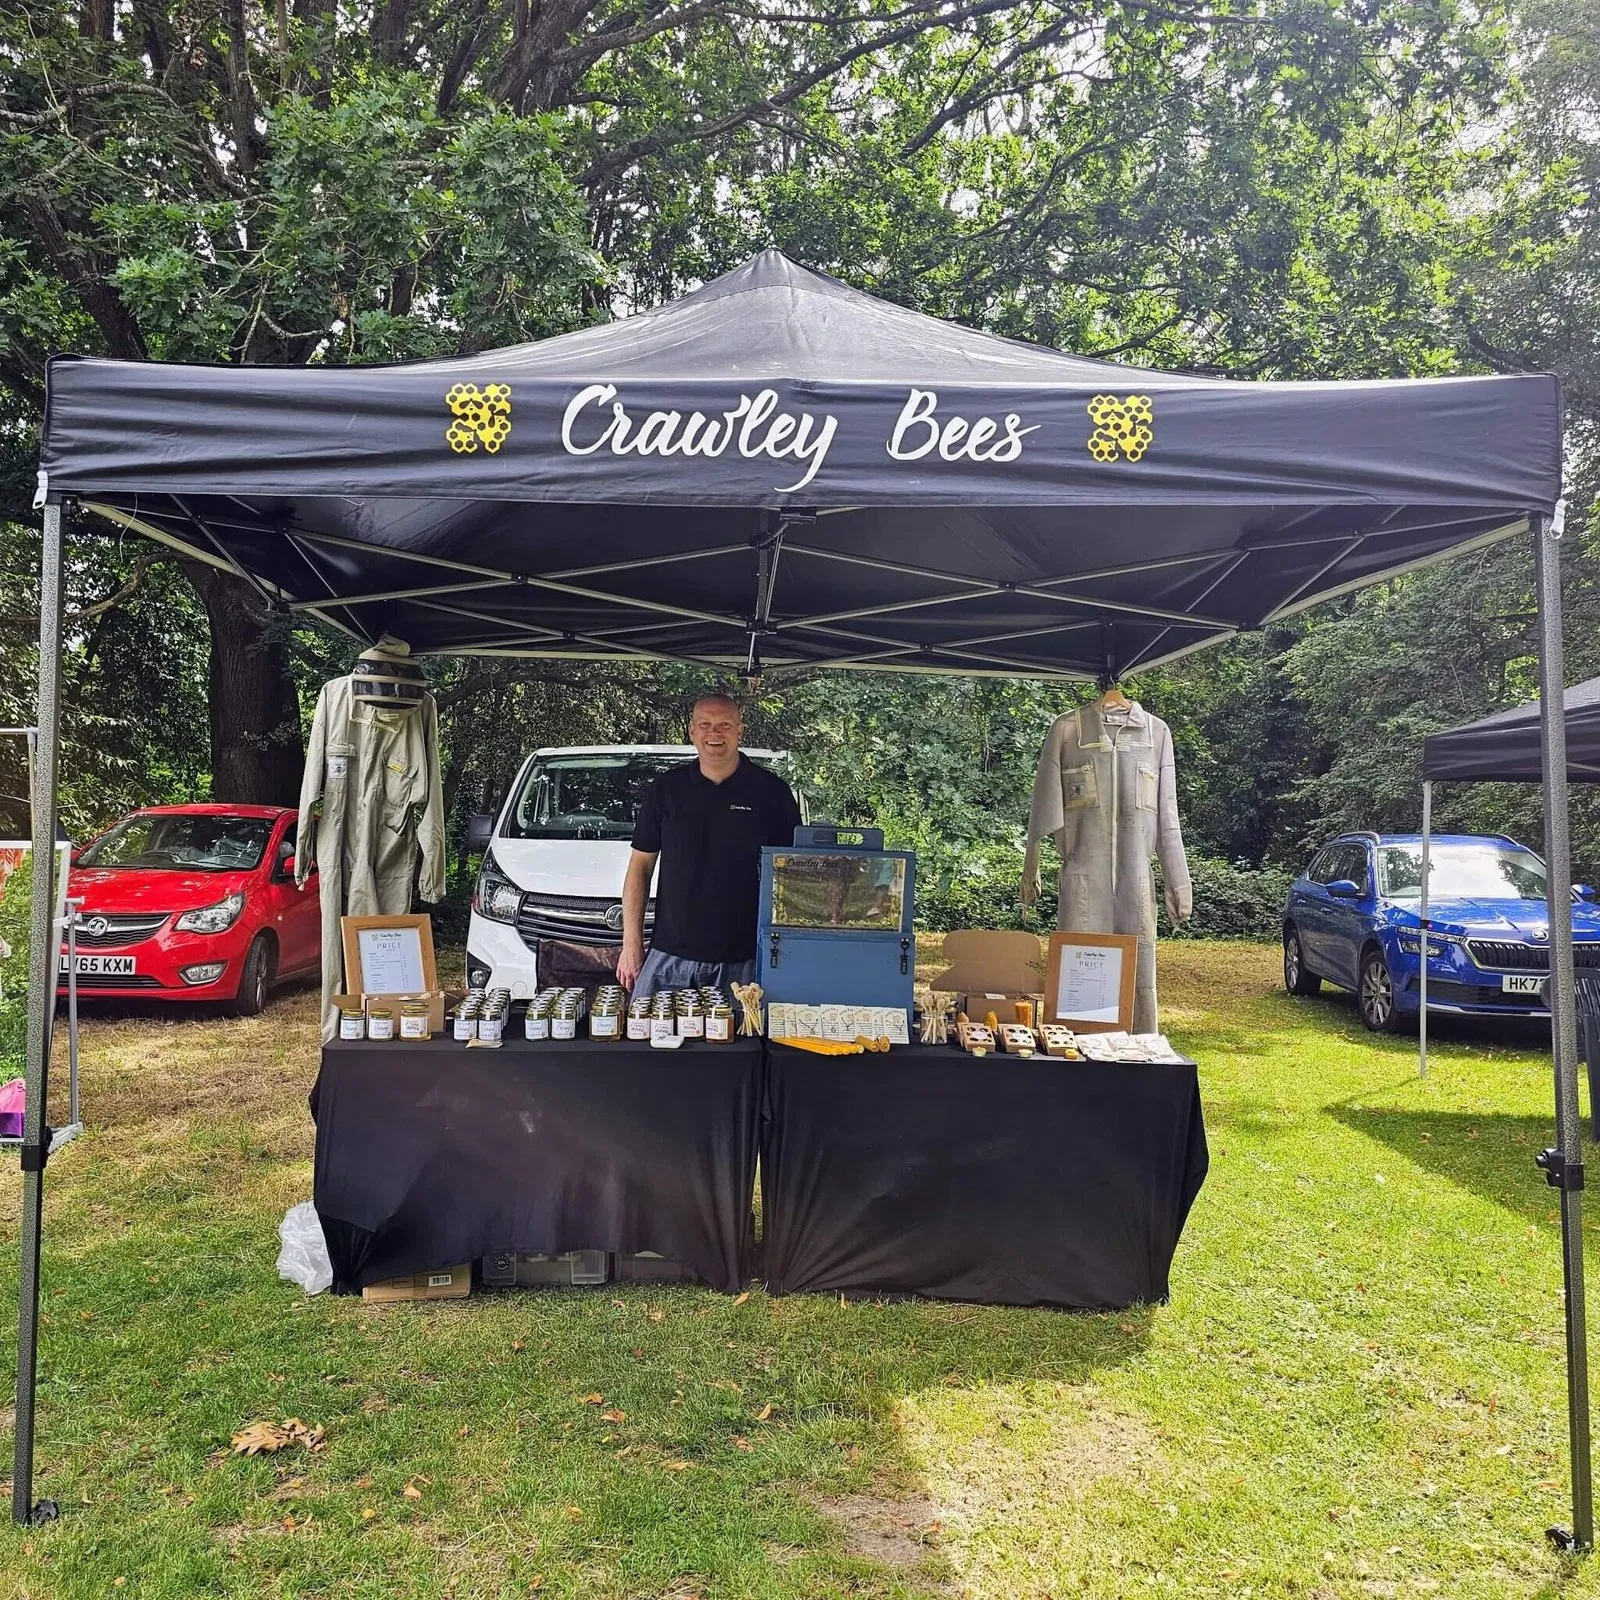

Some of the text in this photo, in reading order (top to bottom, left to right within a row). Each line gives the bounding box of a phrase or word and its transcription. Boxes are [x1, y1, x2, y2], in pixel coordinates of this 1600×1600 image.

[562, 384, 1041, 492] Crawley Bees
[103, 958, 133, 973] KXM
